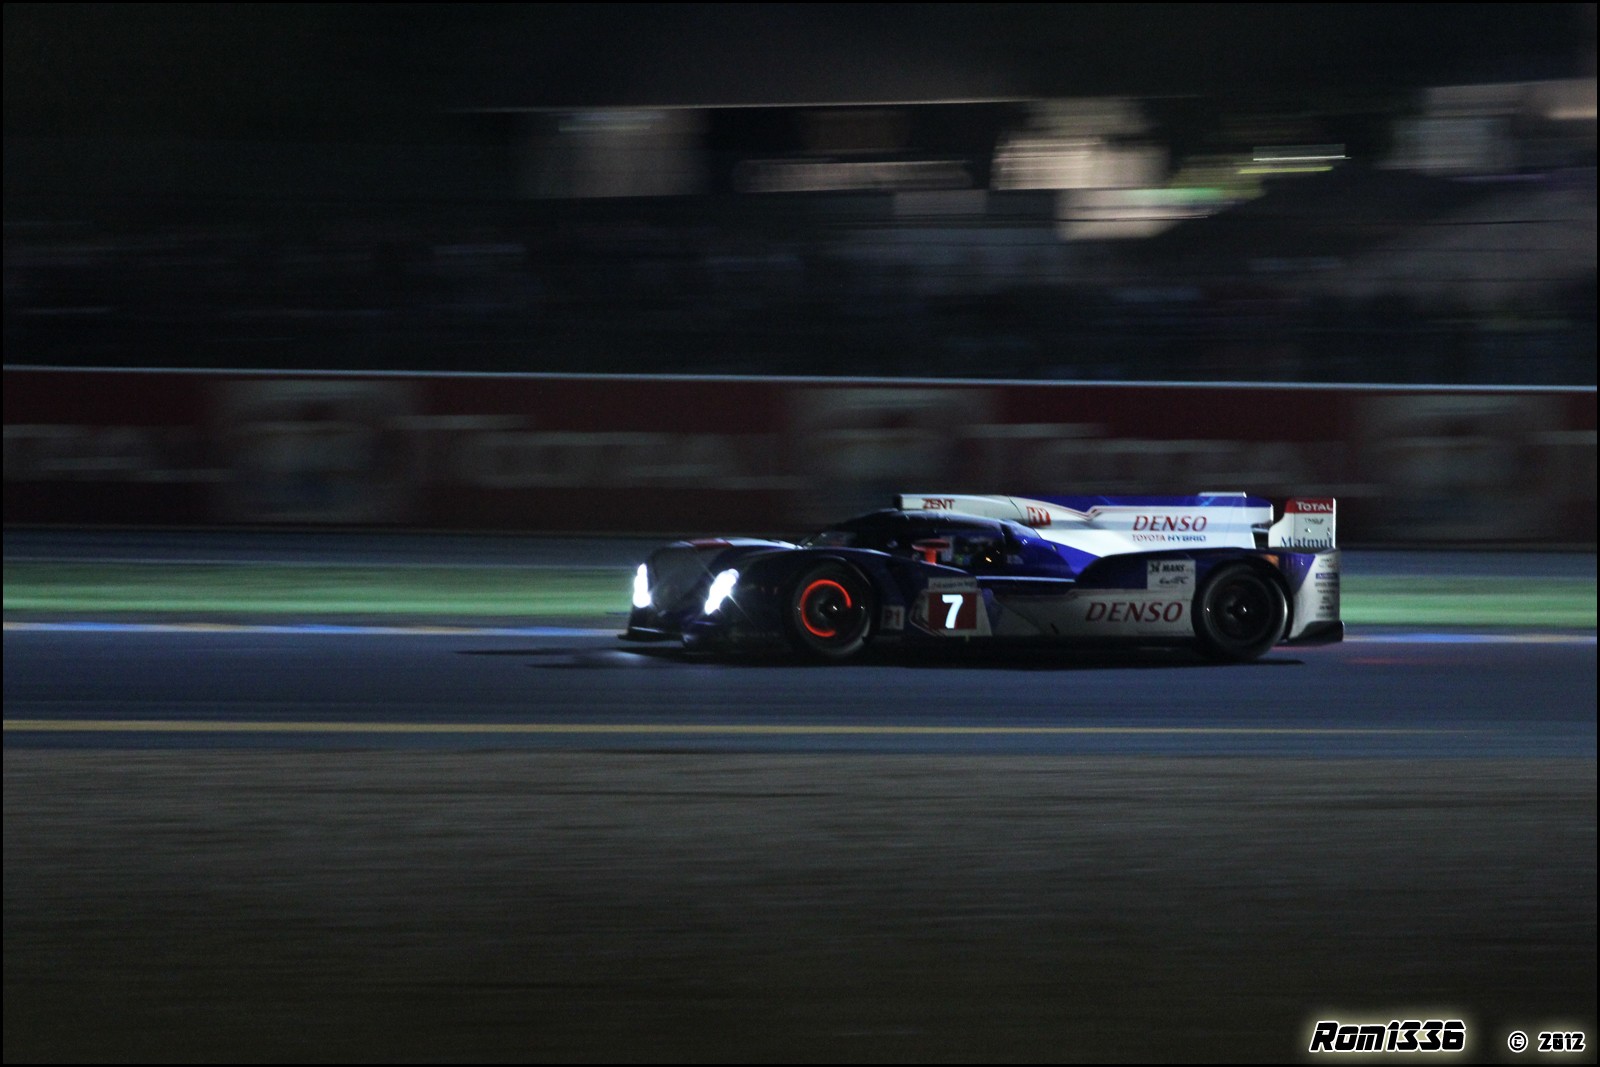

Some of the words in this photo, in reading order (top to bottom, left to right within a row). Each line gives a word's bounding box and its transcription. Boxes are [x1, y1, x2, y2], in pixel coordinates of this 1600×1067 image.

[922, 498, 955, 510] ZENT
[1296, 501, 1333, 511] TOTAL
[1132, 515, 1208, 532] DENSO
[1132, 534, 1166, 542] TOYOTA
[1167, 534, 1207, 542] HYBRID
[1280, 536, 1333, 548] Matmut
[884, 608, 900, 625] P1
[941, 593, 964, 630] 7
[1085, 601, 1183, 622] DENSO
